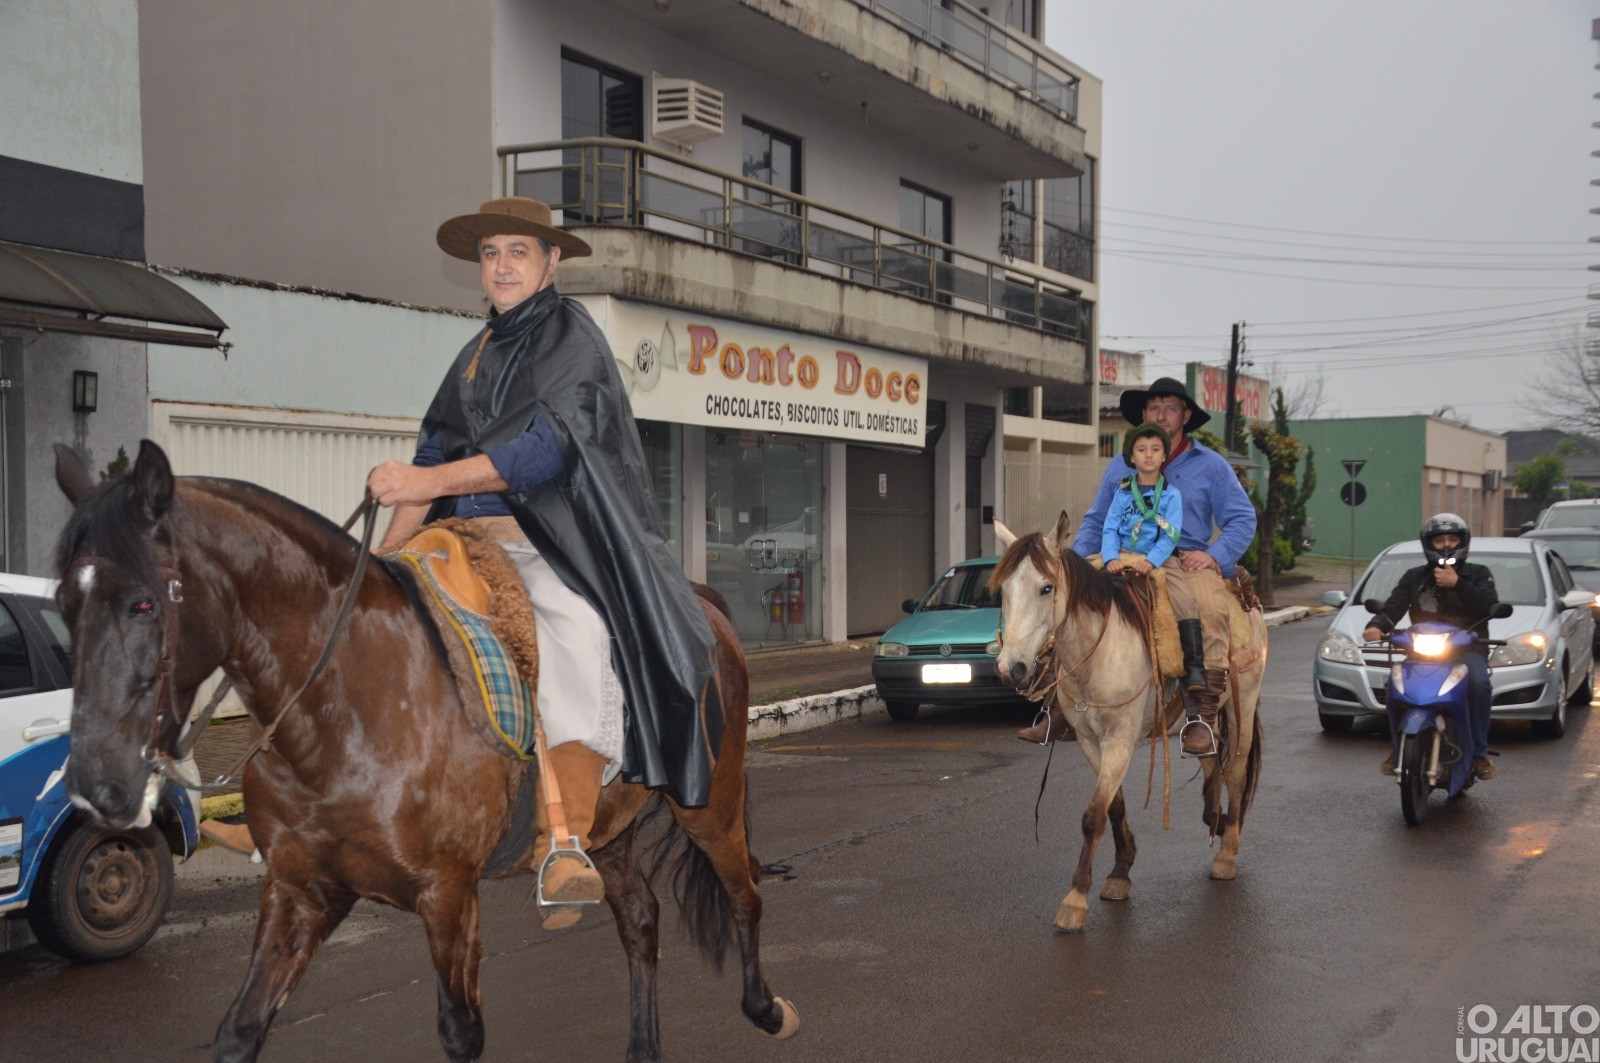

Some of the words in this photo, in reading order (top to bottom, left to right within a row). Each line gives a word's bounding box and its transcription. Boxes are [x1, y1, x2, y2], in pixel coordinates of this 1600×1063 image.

[687, 324, 819, 389] Ponto
[834, 350, 920, 405] Doce
[705, 394, 784, 426] CHOCOLATES,
[787, 404, 839, 427] BISCOITOS
[843, 412, 865, 429] UTIL.
[866, 410, 918, 436] DOMÉSTICAS
